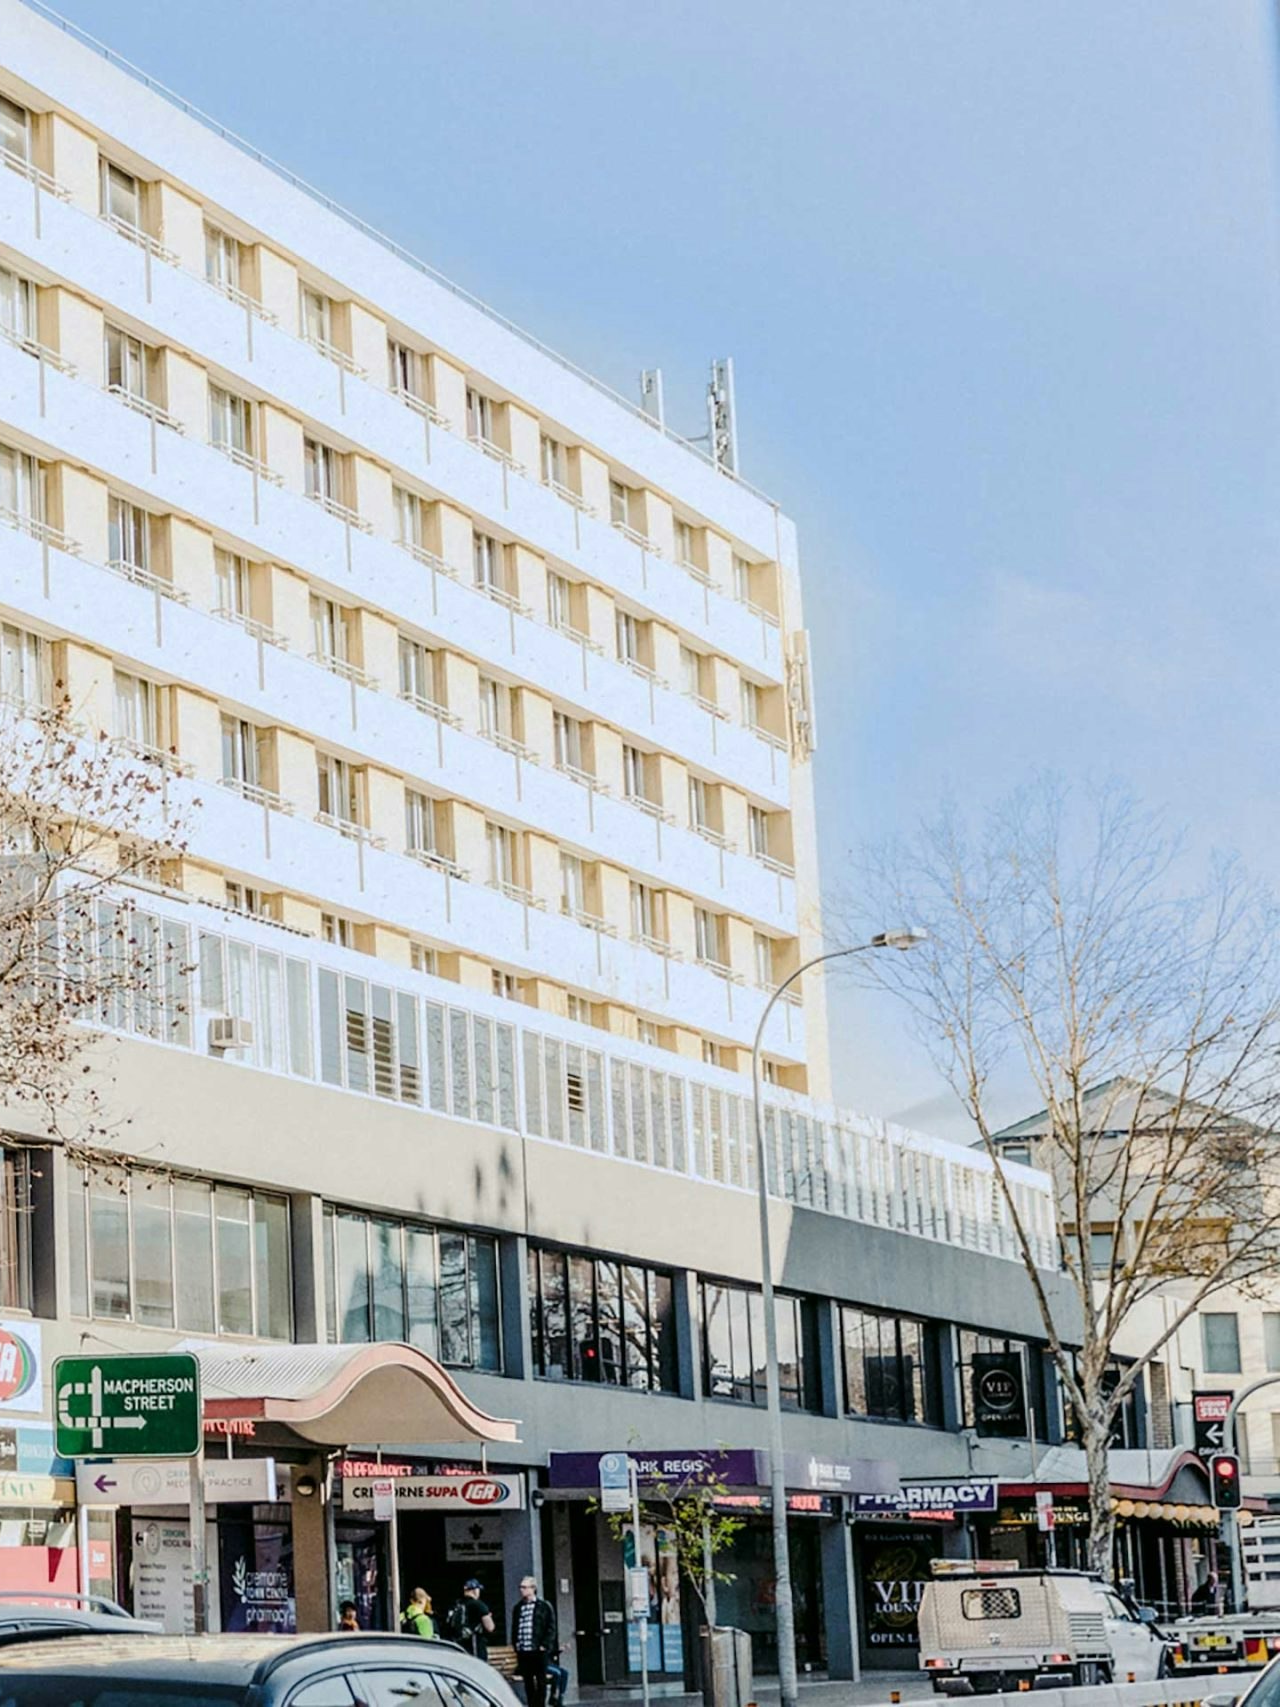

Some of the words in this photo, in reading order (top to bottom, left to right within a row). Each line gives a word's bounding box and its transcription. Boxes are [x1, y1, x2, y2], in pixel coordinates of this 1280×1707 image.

[103, 1378, 194, 1394] MACPHERSON
[124, 1395, 176, 1411] STREET
[663, 1459, 705, 1473] REGIS
[209, 1477, 252, 1488] PRACTICE
[352, 1486, 424, 1499] CRRNE
[425, 1486, 458, 1498] SUPA
[465, 1482, 497, 1500] IGA
[858, 1486, 990, 1505] PHARMACY
[1052, 1511, 1090, 1522] OUNGE
[875, 1602, 920, 1613] LOUN
